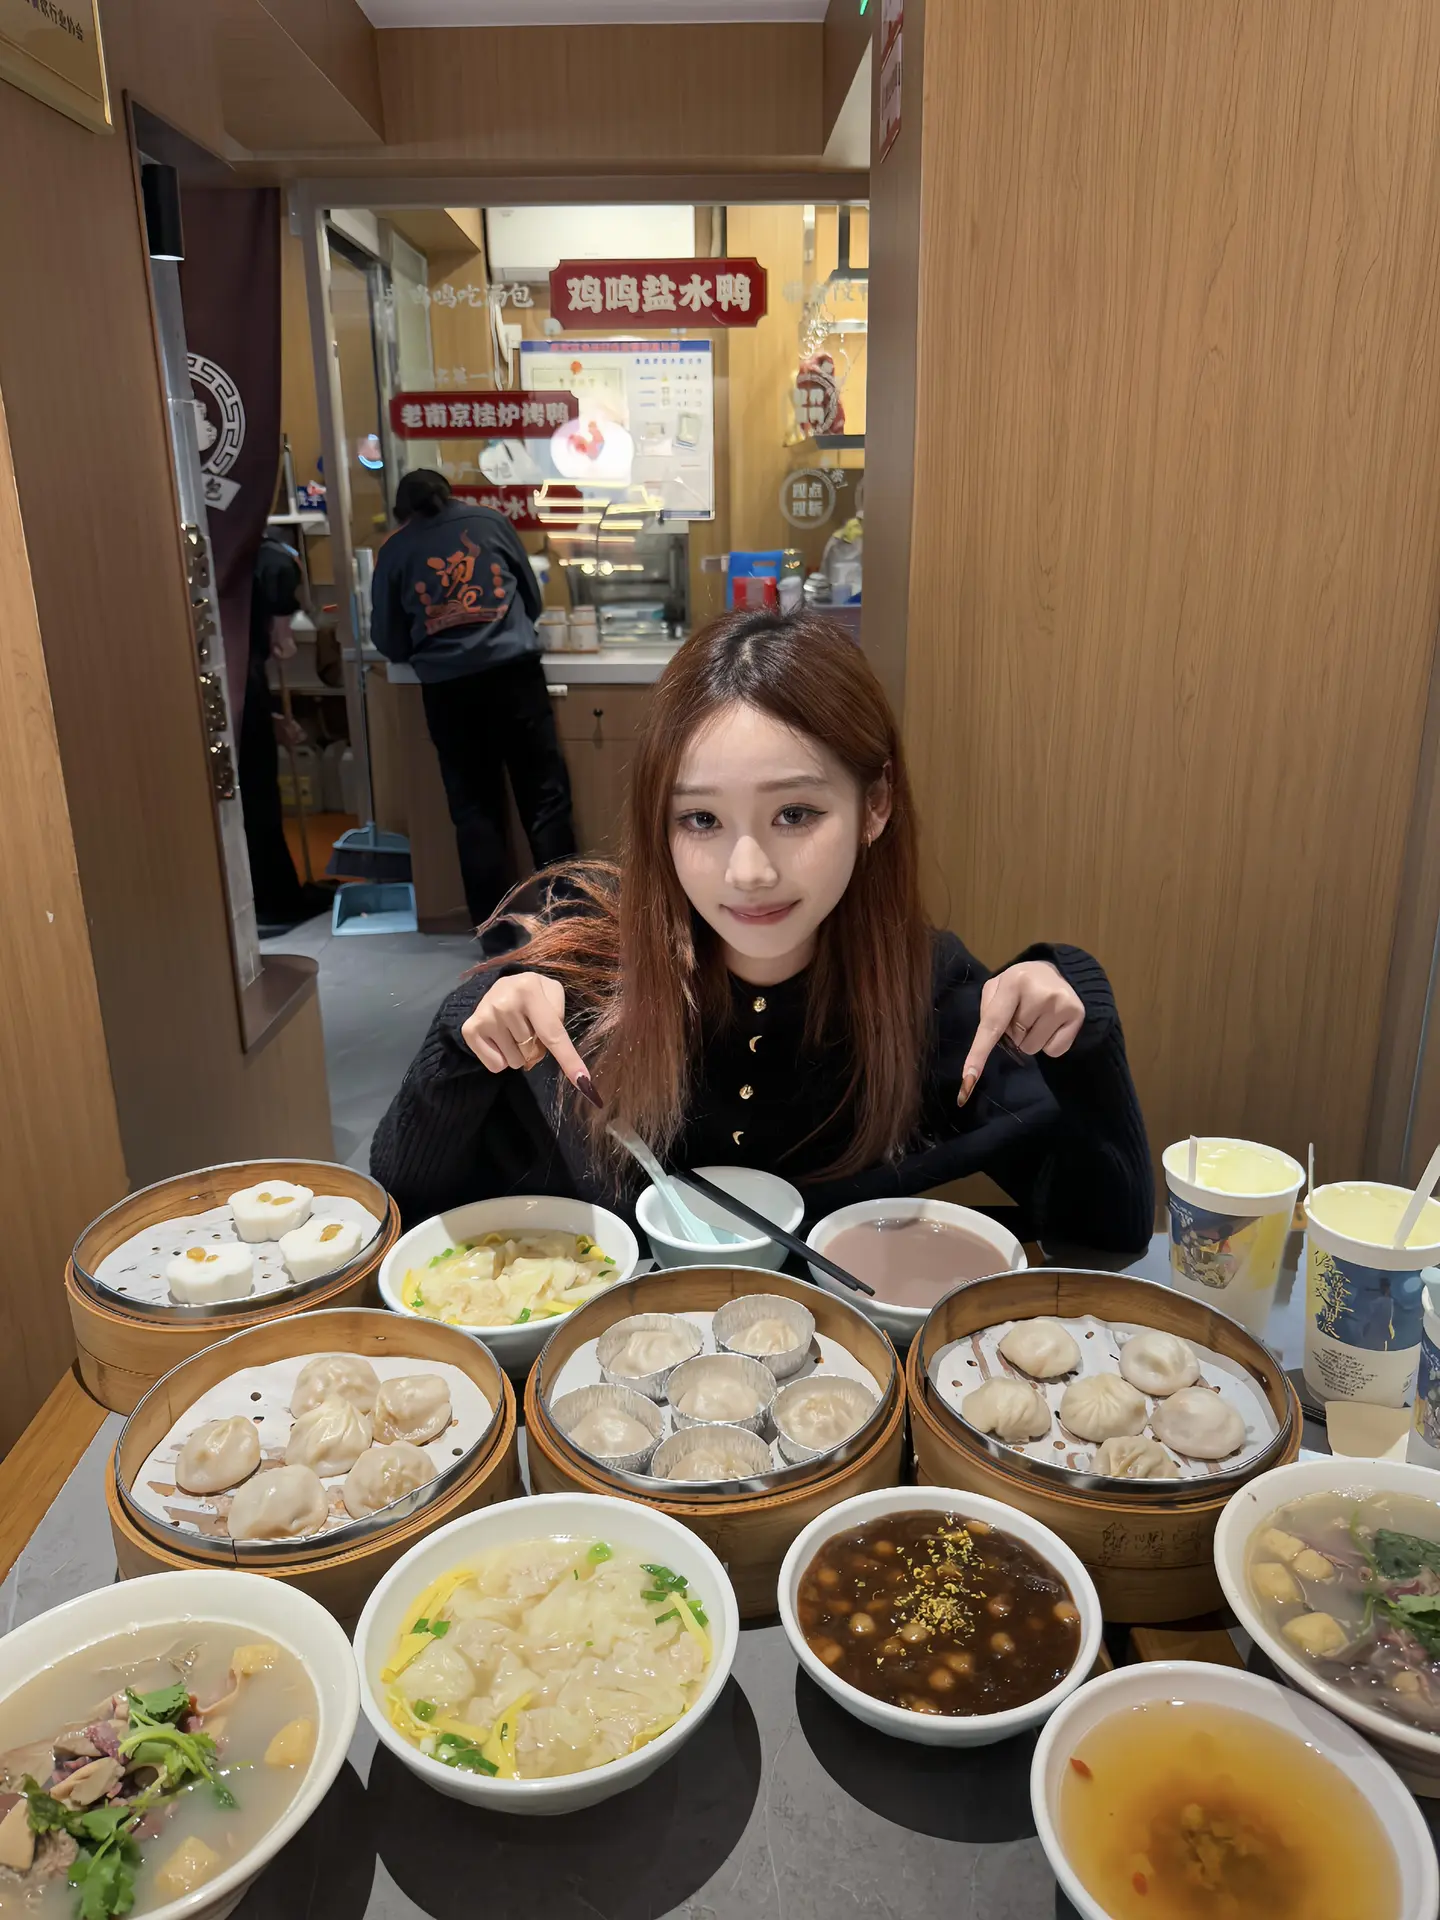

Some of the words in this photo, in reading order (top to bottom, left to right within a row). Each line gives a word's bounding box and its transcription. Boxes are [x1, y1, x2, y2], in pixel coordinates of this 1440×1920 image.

[566, 273, 752, 314] 鸡鸣盐水鸭
[401, 402, 569, 429] 老南京挂炉烤鸭
